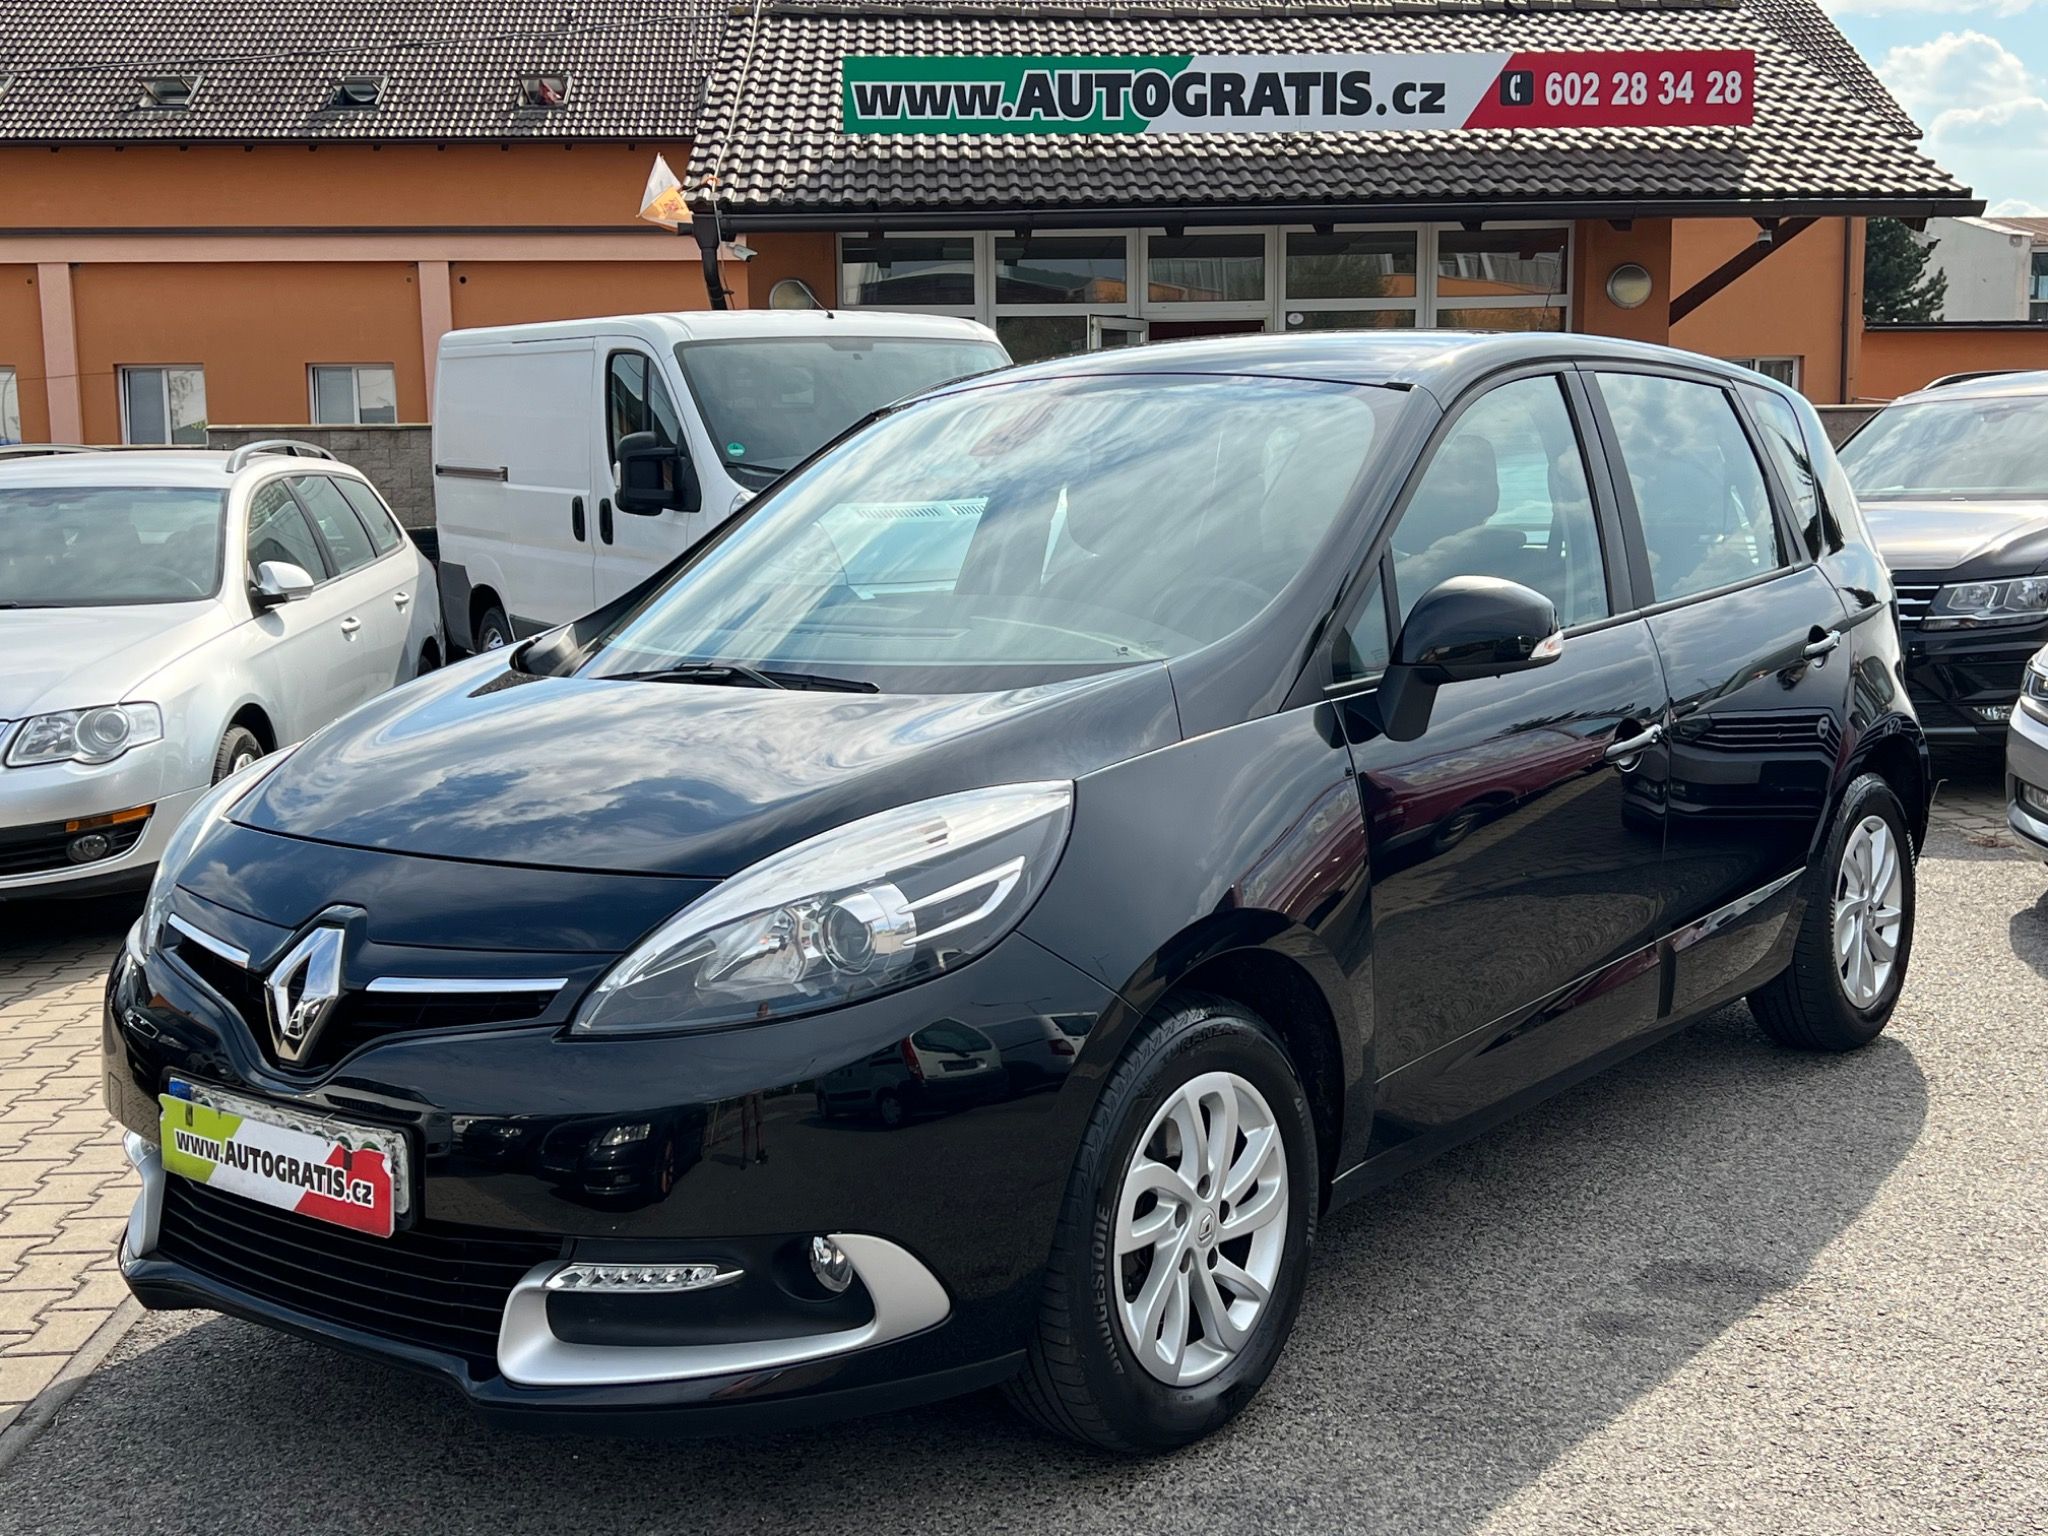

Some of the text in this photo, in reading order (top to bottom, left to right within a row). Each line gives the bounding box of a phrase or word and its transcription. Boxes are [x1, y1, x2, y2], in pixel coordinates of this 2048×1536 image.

[852, 70, 1446, 119] www.AUTOGRATIS.cz
[1545, 70, 1742, 106] 602 28 34 28
[175, 1130, 373, 1207] www.AUTOGRATIS.cz
